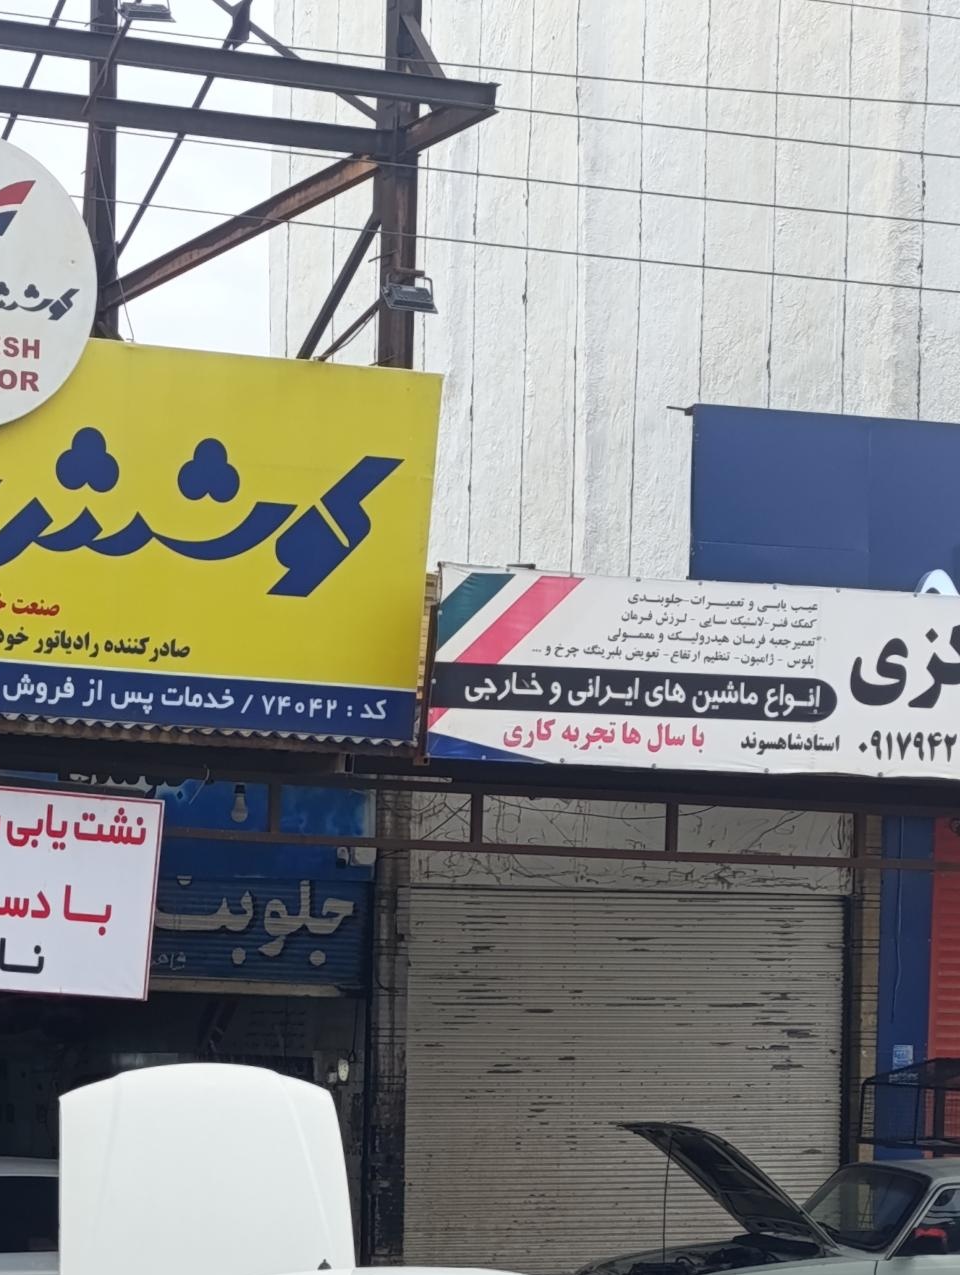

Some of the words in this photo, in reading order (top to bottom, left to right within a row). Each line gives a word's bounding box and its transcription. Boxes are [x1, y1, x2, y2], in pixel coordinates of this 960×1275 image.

[12, 598, 60, 616] صنعت
[628, 592, 681, 607] جلوبندی
[690, 595, 745, 609] تعمیرات
[748, 600, 754, 611] و
[757, 600, 786, 612] یابی
[791, 602, 818, 613] عیب
[621, 610, 652, 624] فرمان
[655, 612, 687, 626] لرزش
[791, 618, 818, 629] کمک
[34, 630, 99, 657] رادیاتور
[608, 627, 655, 642] معمولی
[658, 632, 664, 643] و
[668, 631, 729, 646] هیدرولیک
[733, 634, 765, 648] فرمان
[545, 645, 551, 656] و
[554, 643, 579, 657] چرخ
[583, 644, 622, 660] بلبرینگ
[625, 647, 659, 661] تعویض
[704, 650, 731, 664] تنظیم
[2, 674, 75, 705] فروش
[83, 679, 102, 707] از
[161, 686, 235, 709] خدمات
[465, 672, 544, 702] خارجی
[549, 679, 562, 705] و
[567, 675, 640, 706] ایرانی
[645, 679, 686, 707] های
[692, 681, 758, 712] ماشین
[111, 690, 154, 714] پس
[262, 695, 338, 719] ۷۴۰۴۲
[360, 699, 387, 719] کد
[764, 684, 821, 718] انواع
[503, 718, 556, 748] کاری
[562, 722, 616, 750] تجربه
[622, 720, 641, 744] ها
[647, 722, 685, 752] سال
[691, 724, 704, 753] با
[6, 803, 69, 850] یابی
[73, 806, 148, 846] نشت
[63, 884, 113, 936] با
